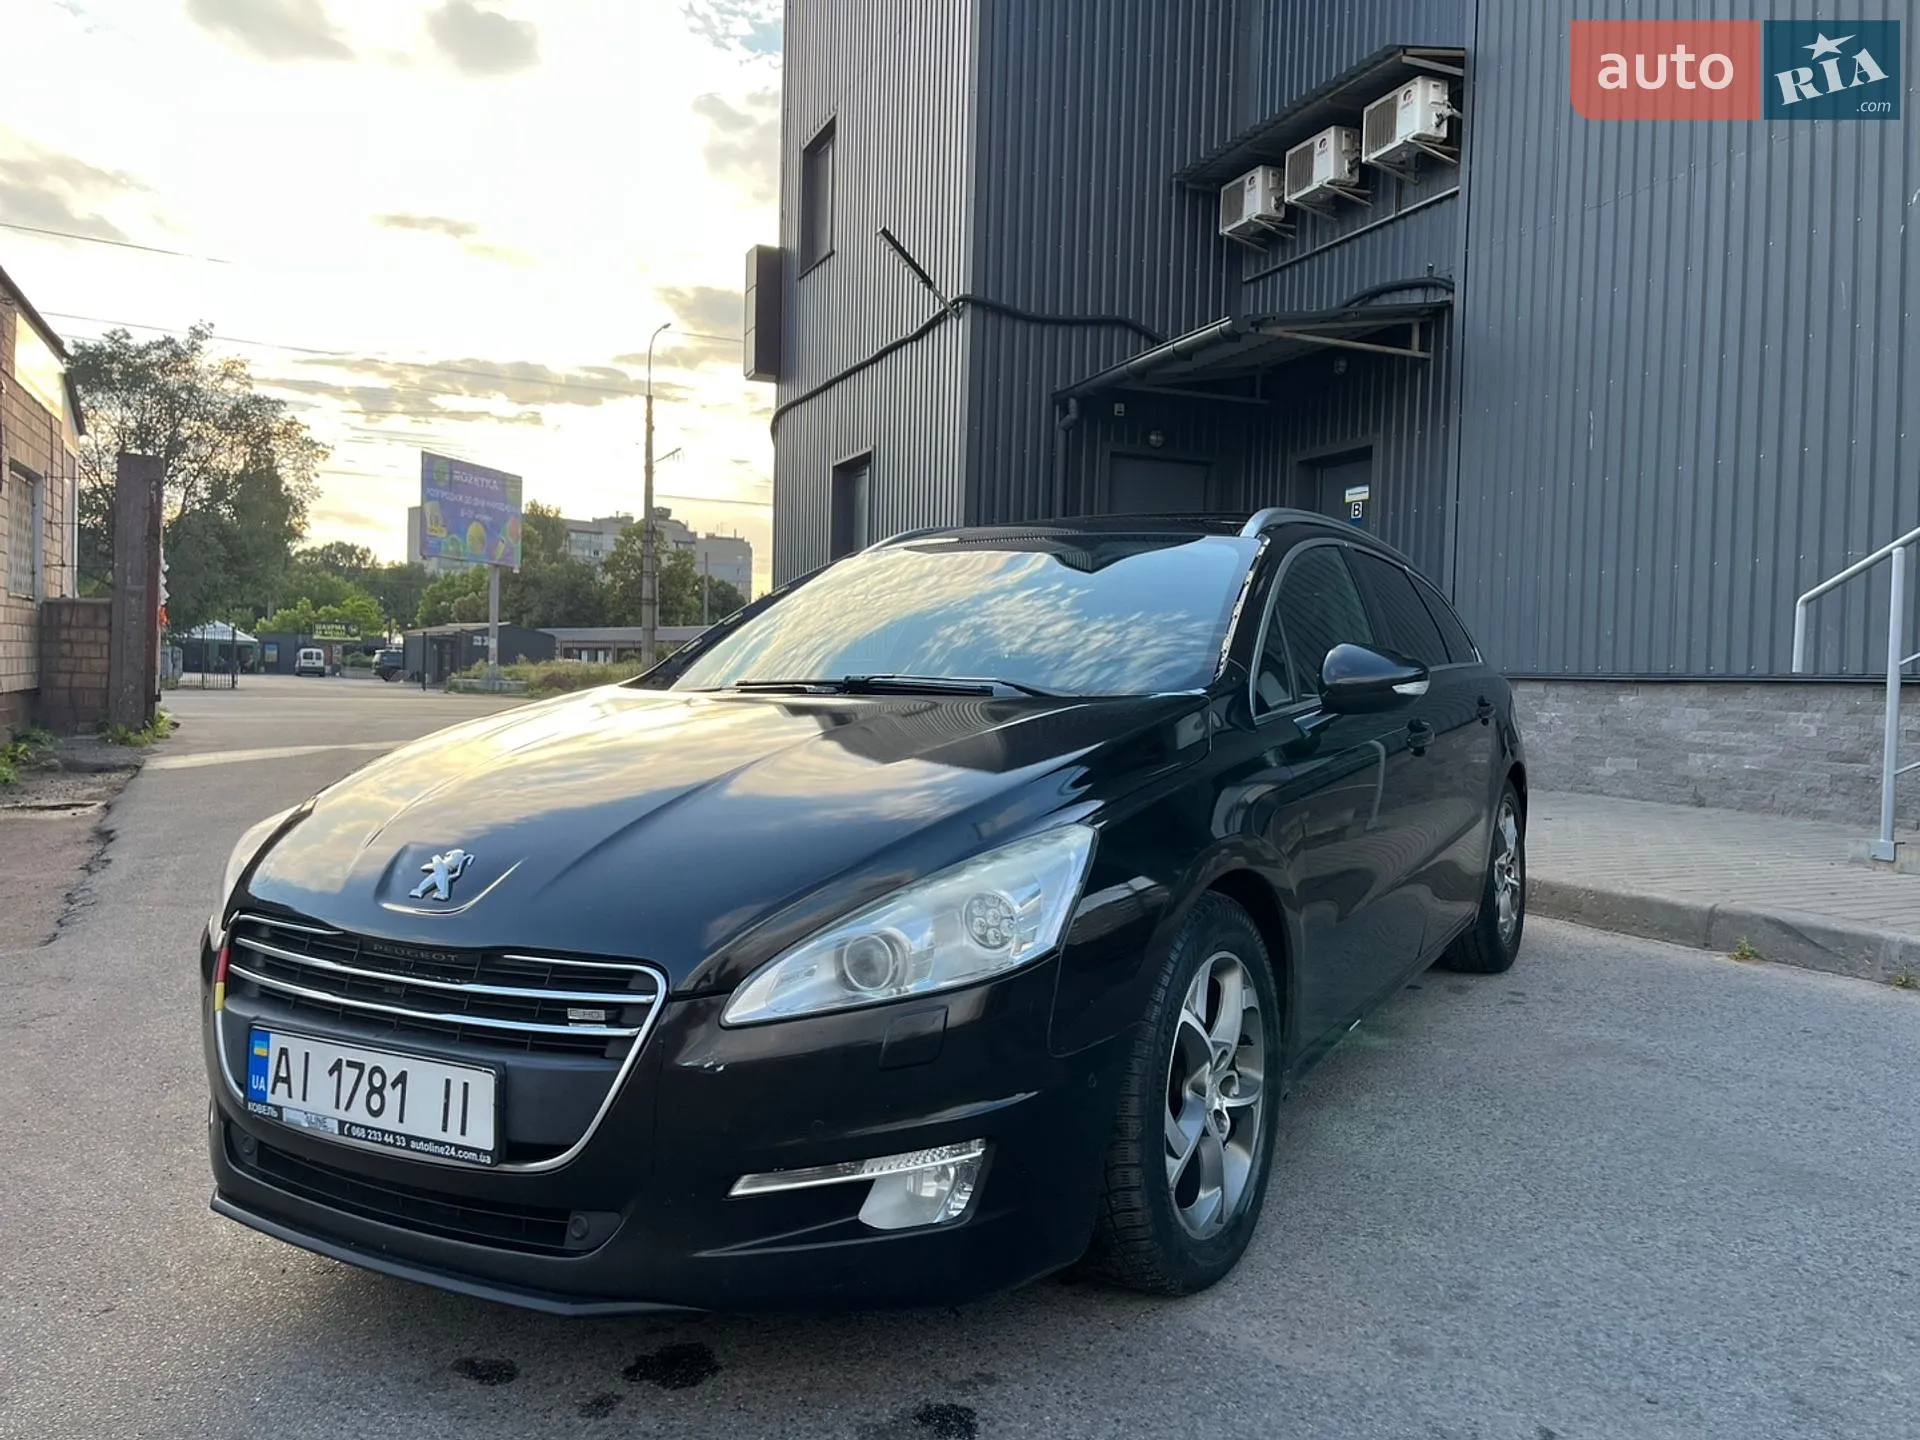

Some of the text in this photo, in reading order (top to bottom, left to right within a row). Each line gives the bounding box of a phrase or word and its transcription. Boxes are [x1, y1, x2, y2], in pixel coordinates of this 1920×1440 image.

[373, 943, 459, 961] PEUGEOT
[251, 1074, 266, 1092] UA
[270, 1047, 310, 1102] AI
[328, 1058, 408, 1124] 1781
[367, 1128, 383, 1142] 233
[395, 1135, 407, 1146] 33
[410, 1139, 492, 1164] autoline24.com.ua
